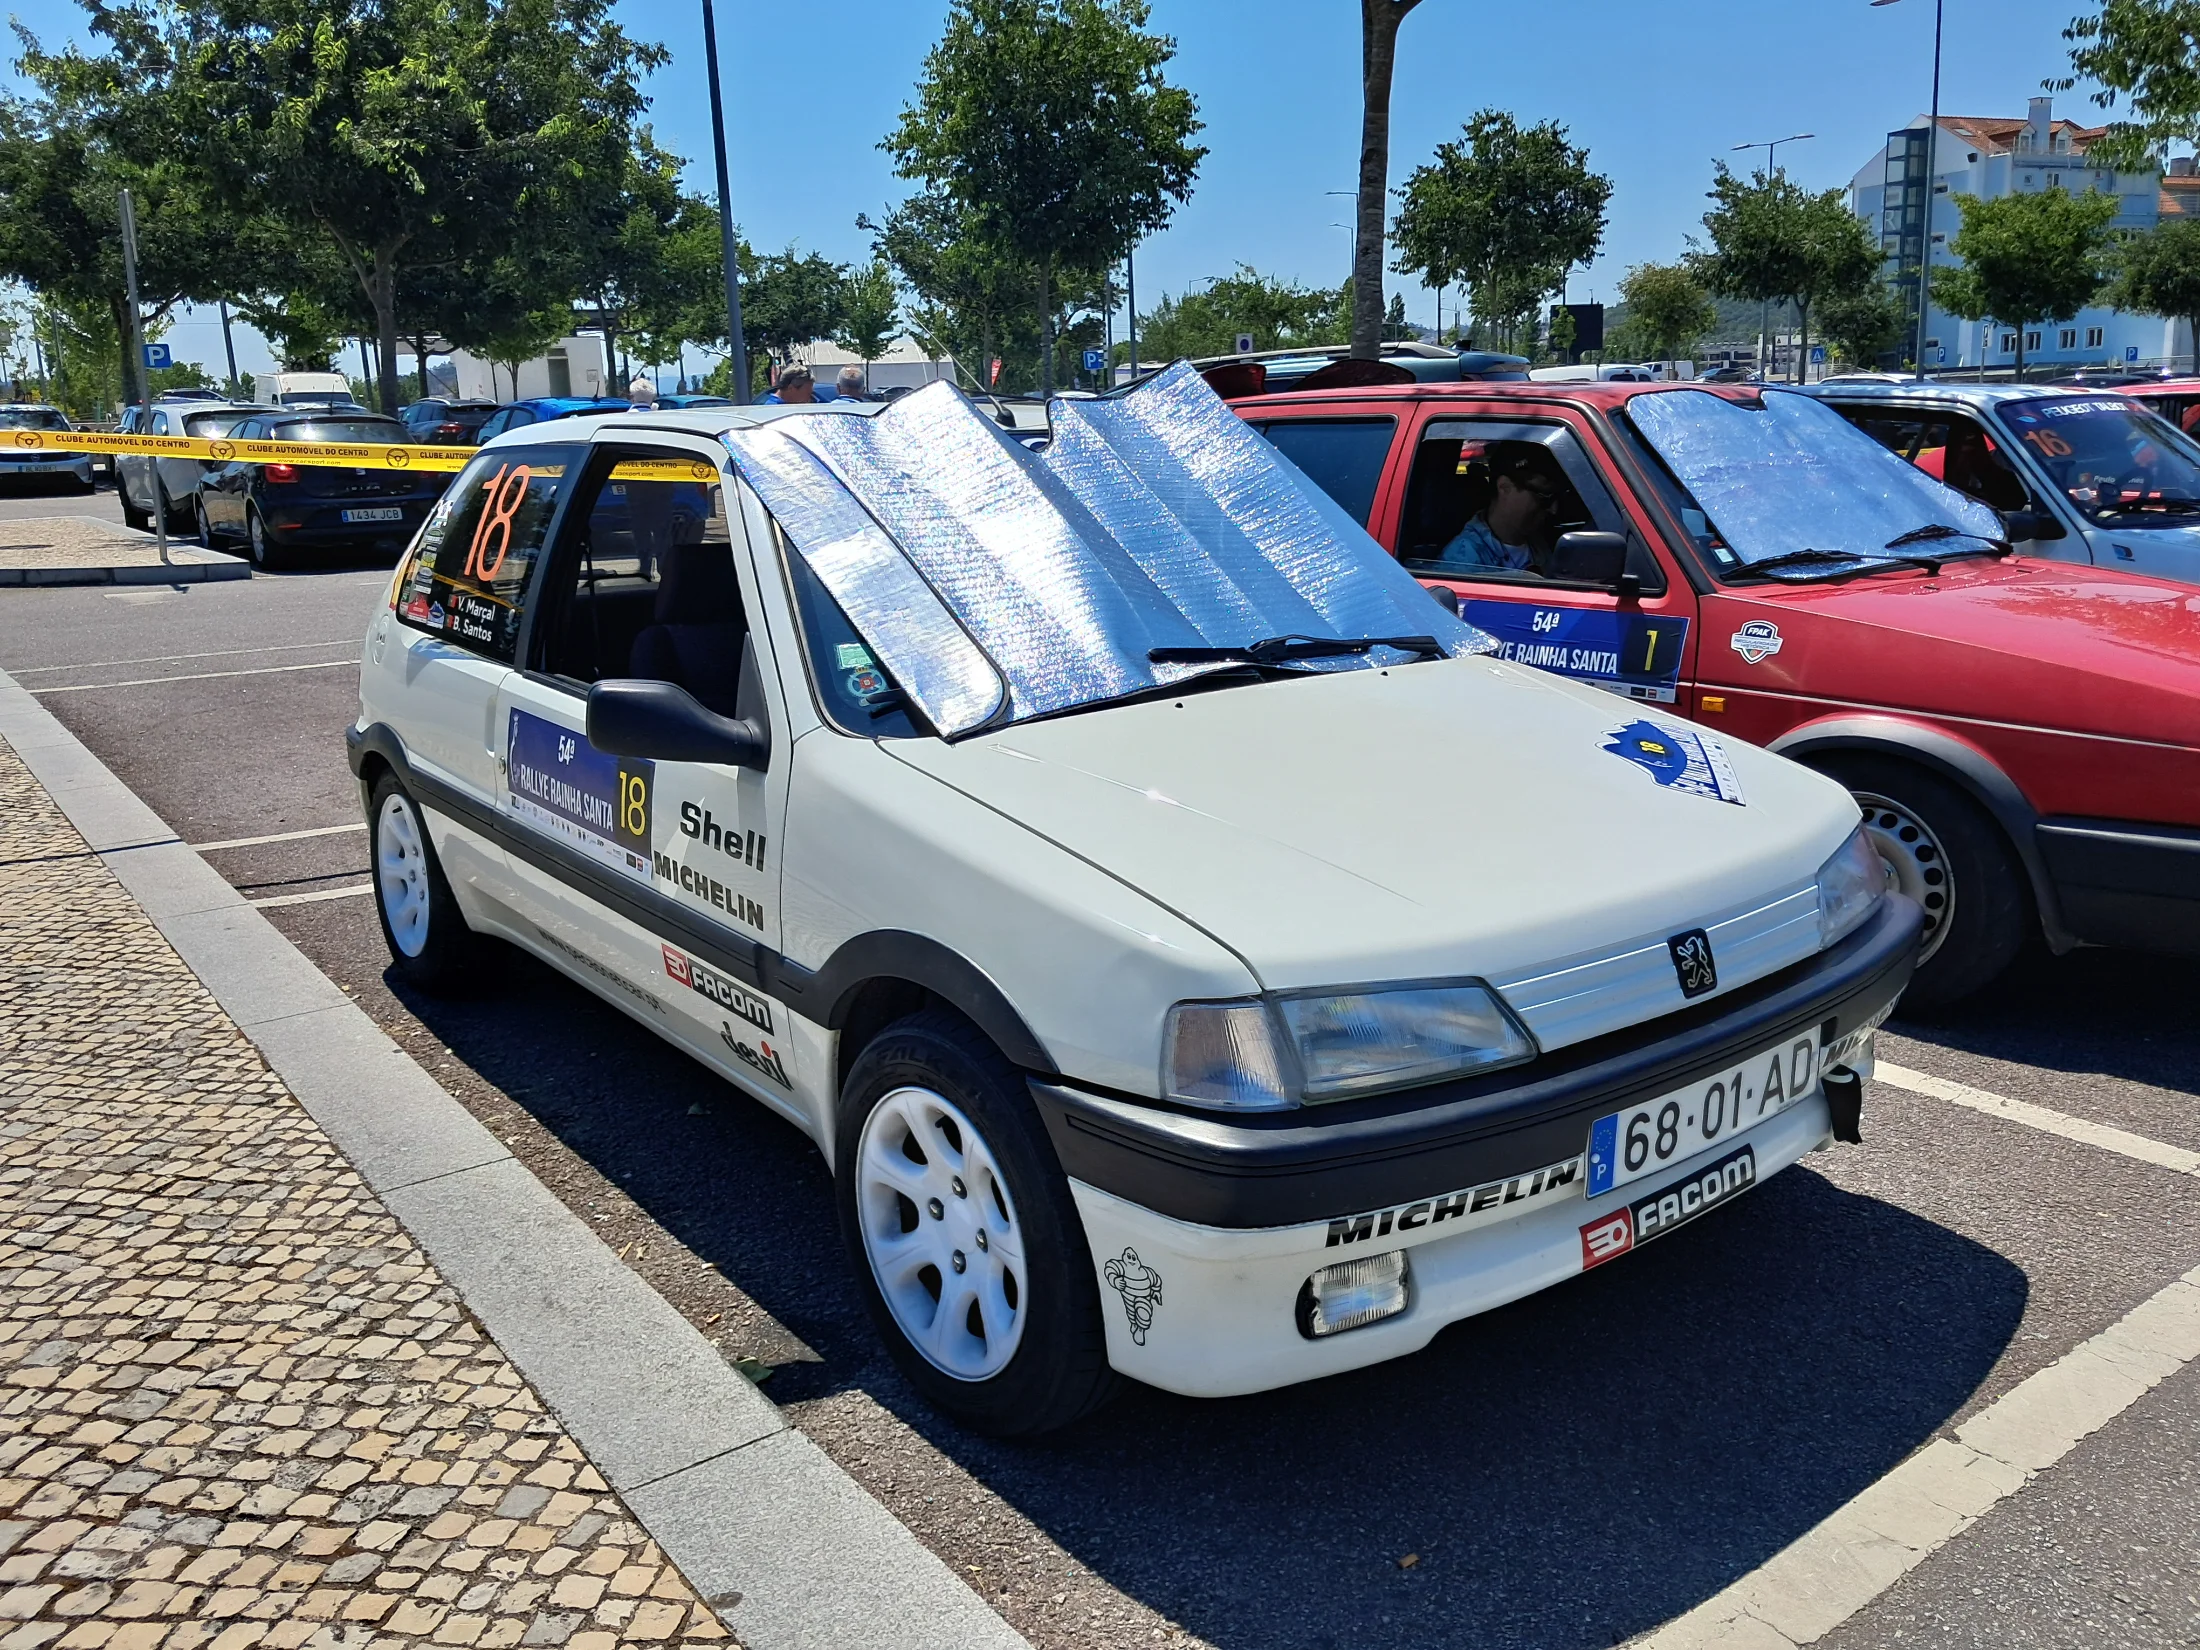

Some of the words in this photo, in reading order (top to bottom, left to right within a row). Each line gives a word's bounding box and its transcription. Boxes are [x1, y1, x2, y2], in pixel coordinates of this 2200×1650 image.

[147, 346, 165, 366] P
[1086, 352, 1097, 368] P
[2041, 402, 2095, 418] PEUGEOT
[55, 434, 85, 443] CLUBE
[142, 439, 154, 447] DO
[156, 440, 191, 449] CENTRO
[247, 444, 274, 453] CLUBE
[338, 449, 369, 457] CENTRO
[419, 451, 444, 459] CLUBE
[2024, 429, 2072, 457] 16
[350, 510, 377, 520] 1434
[380, 509, 400, 520] JCB
[464, 462, 530, 582] 18
[458, 595, 465, 612] V.
[465, 598, 496, 623] Marçal
[452, 615, 461, 632] B.
[462, 618, 493, 642] Santos
[1747, 627, 1770, 637] FPAK
[1515, 642, 1567, 669] RAINHA
[1569, 648, 1619, 675] SANTA
[1644, 629, 1659, 672] 1
[520, 763, 550, 801] RALLYE
[550, 777, 583, 818] RAINHA
[583, 792, 614, 833] SANTA
[619, 770, 646, 837] 18
[680, 800, 767, 873] Shell
[653, 849, 764, 932] MICHELIN
[691, 964, 772, 1029] FACOM
[720, 1020, 795, 1092] devil
[1595, 1162, 1608, 1182] P
[1324, 1159, 1580, 1248] MICHELIN
[1637, 1153, 1755, 1237] FACOM
